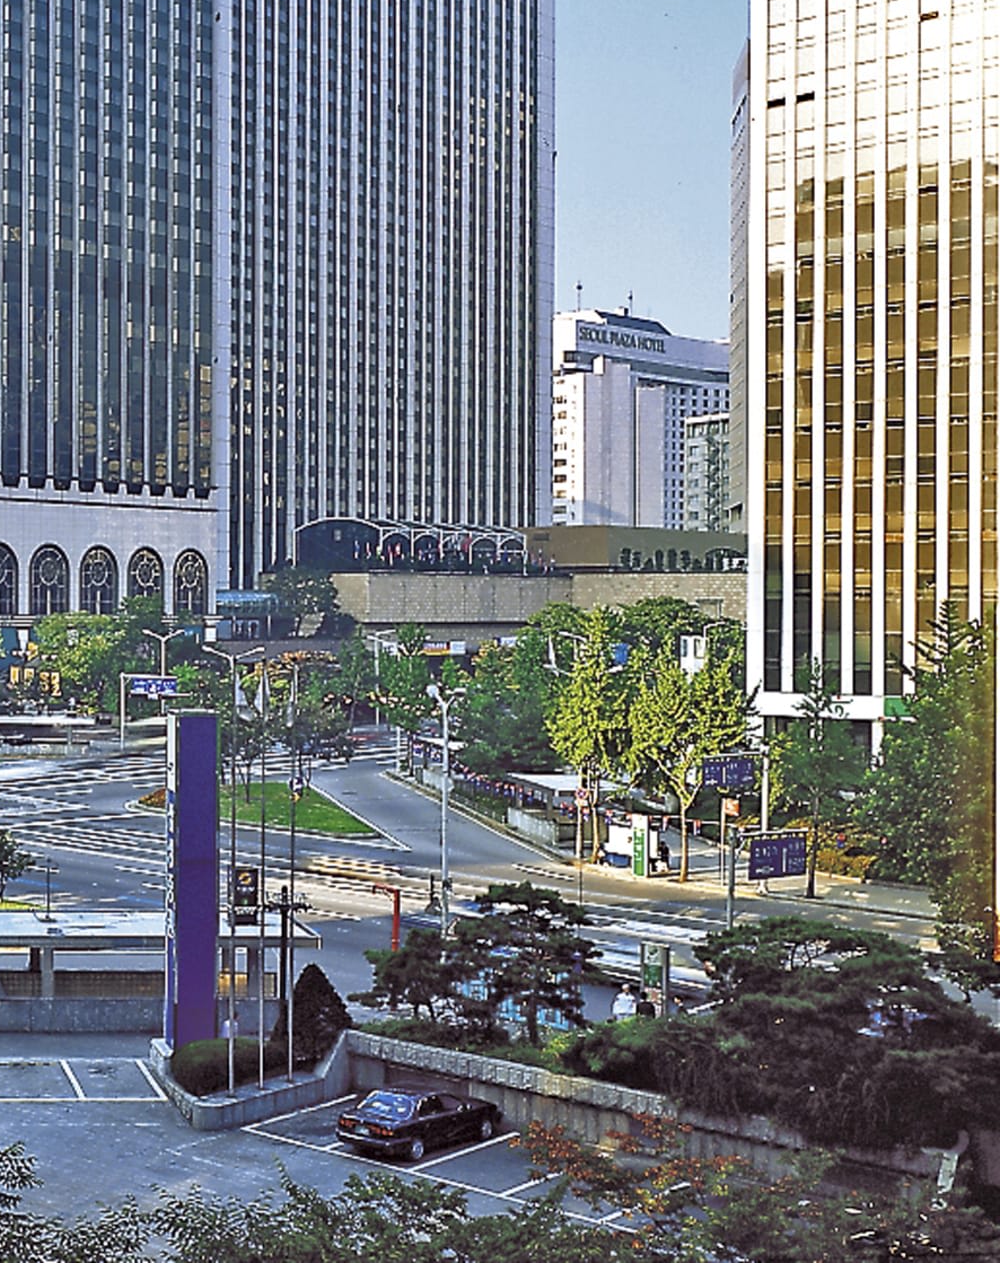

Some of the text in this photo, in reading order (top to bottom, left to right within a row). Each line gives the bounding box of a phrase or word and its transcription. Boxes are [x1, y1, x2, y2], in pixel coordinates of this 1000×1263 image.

[579, 326, 666, 354] SEOUL PLAZA HOTEL
